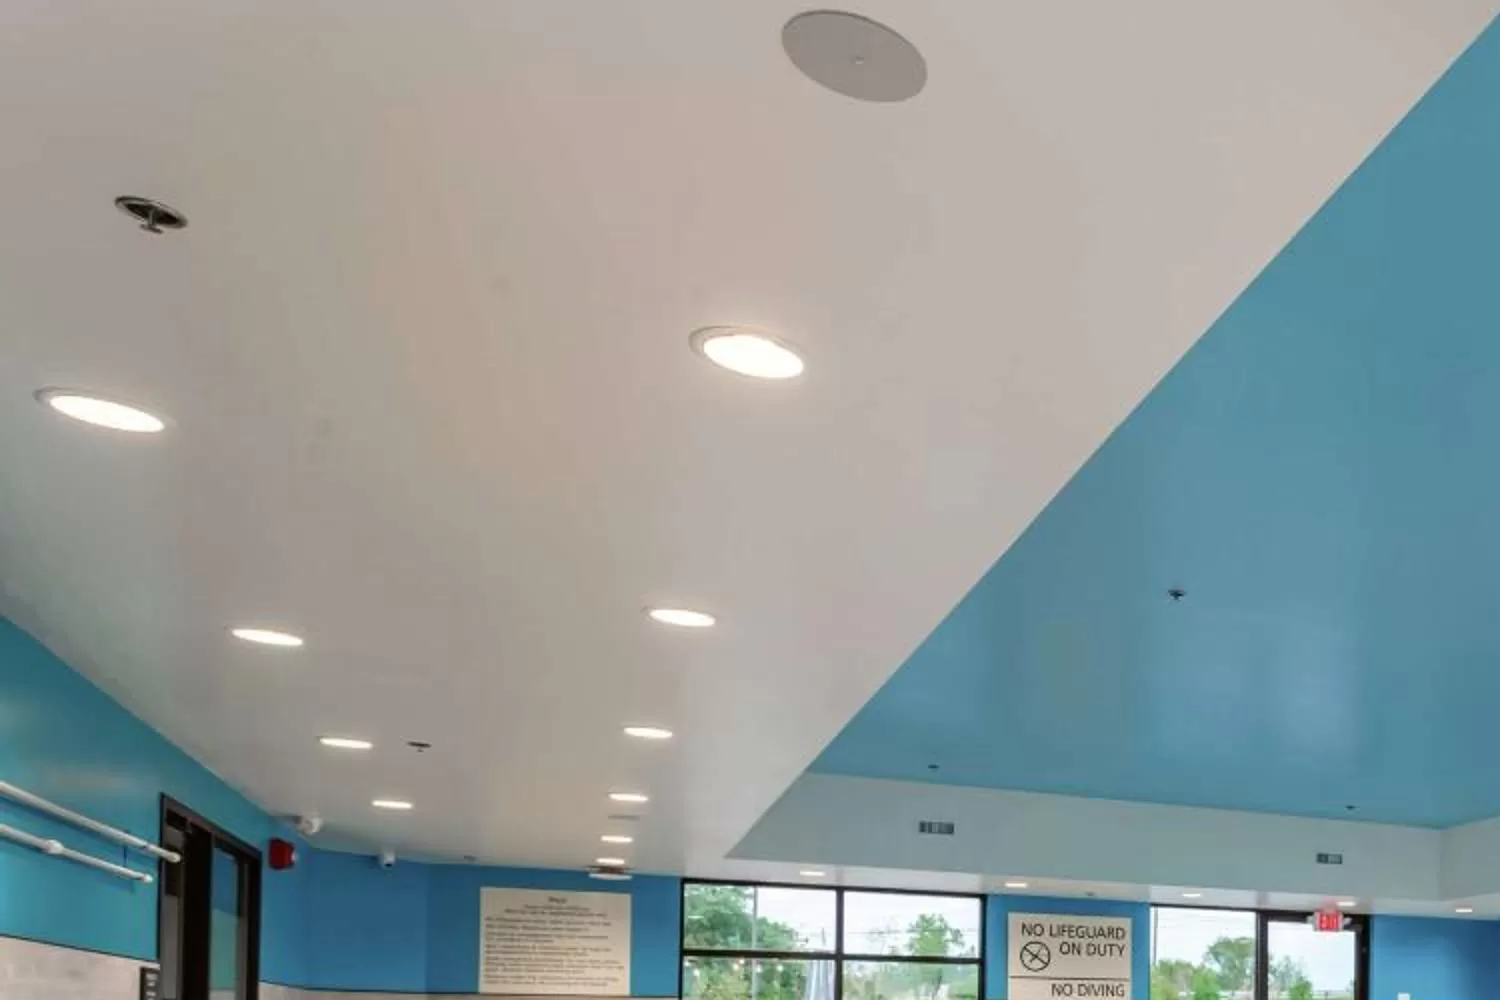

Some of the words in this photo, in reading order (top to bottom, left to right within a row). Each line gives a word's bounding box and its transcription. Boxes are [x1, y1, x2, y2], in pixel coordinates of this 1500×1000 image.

[1021, 922, 1045, 937] NO
[1050, 923, 1126, 940] LIFEGUARD
[1059, 941, 1081, 956] ON
[1086, 943, 1125, 957] DUTY
[1051, 983, 1073, 997] NO
[1077, 984, 1125, 998] DIVING
